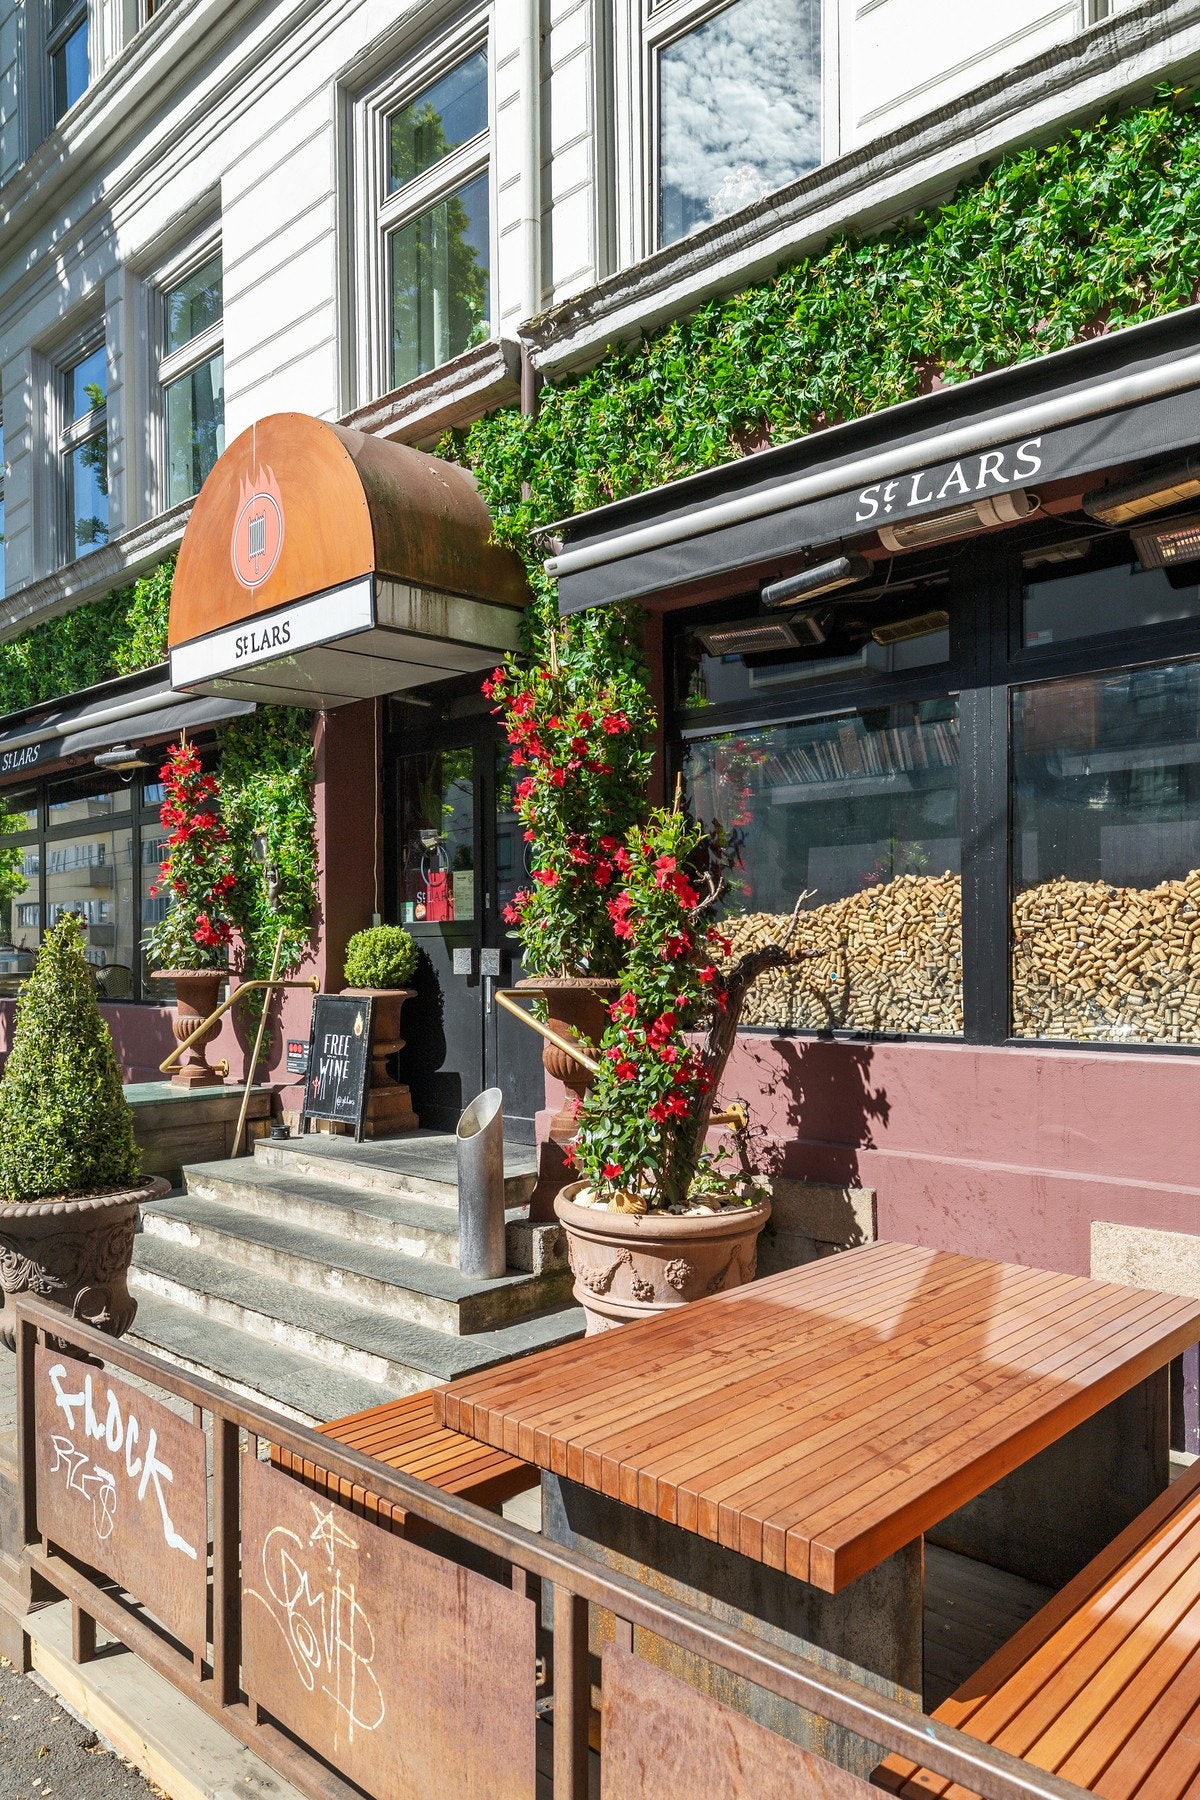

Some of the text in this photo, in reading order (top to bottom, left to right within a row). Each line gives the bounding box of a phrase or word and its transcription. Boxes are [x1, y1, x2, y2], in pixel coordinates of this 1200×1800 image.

[906, 437, 1042, 507] LARS
[250, 620, 291, 653] LARS
[12, 744, 41, 768] LARS
[323, 1033, 352, 1057] FREE
[319, 1057, 350, 1081] WINE
